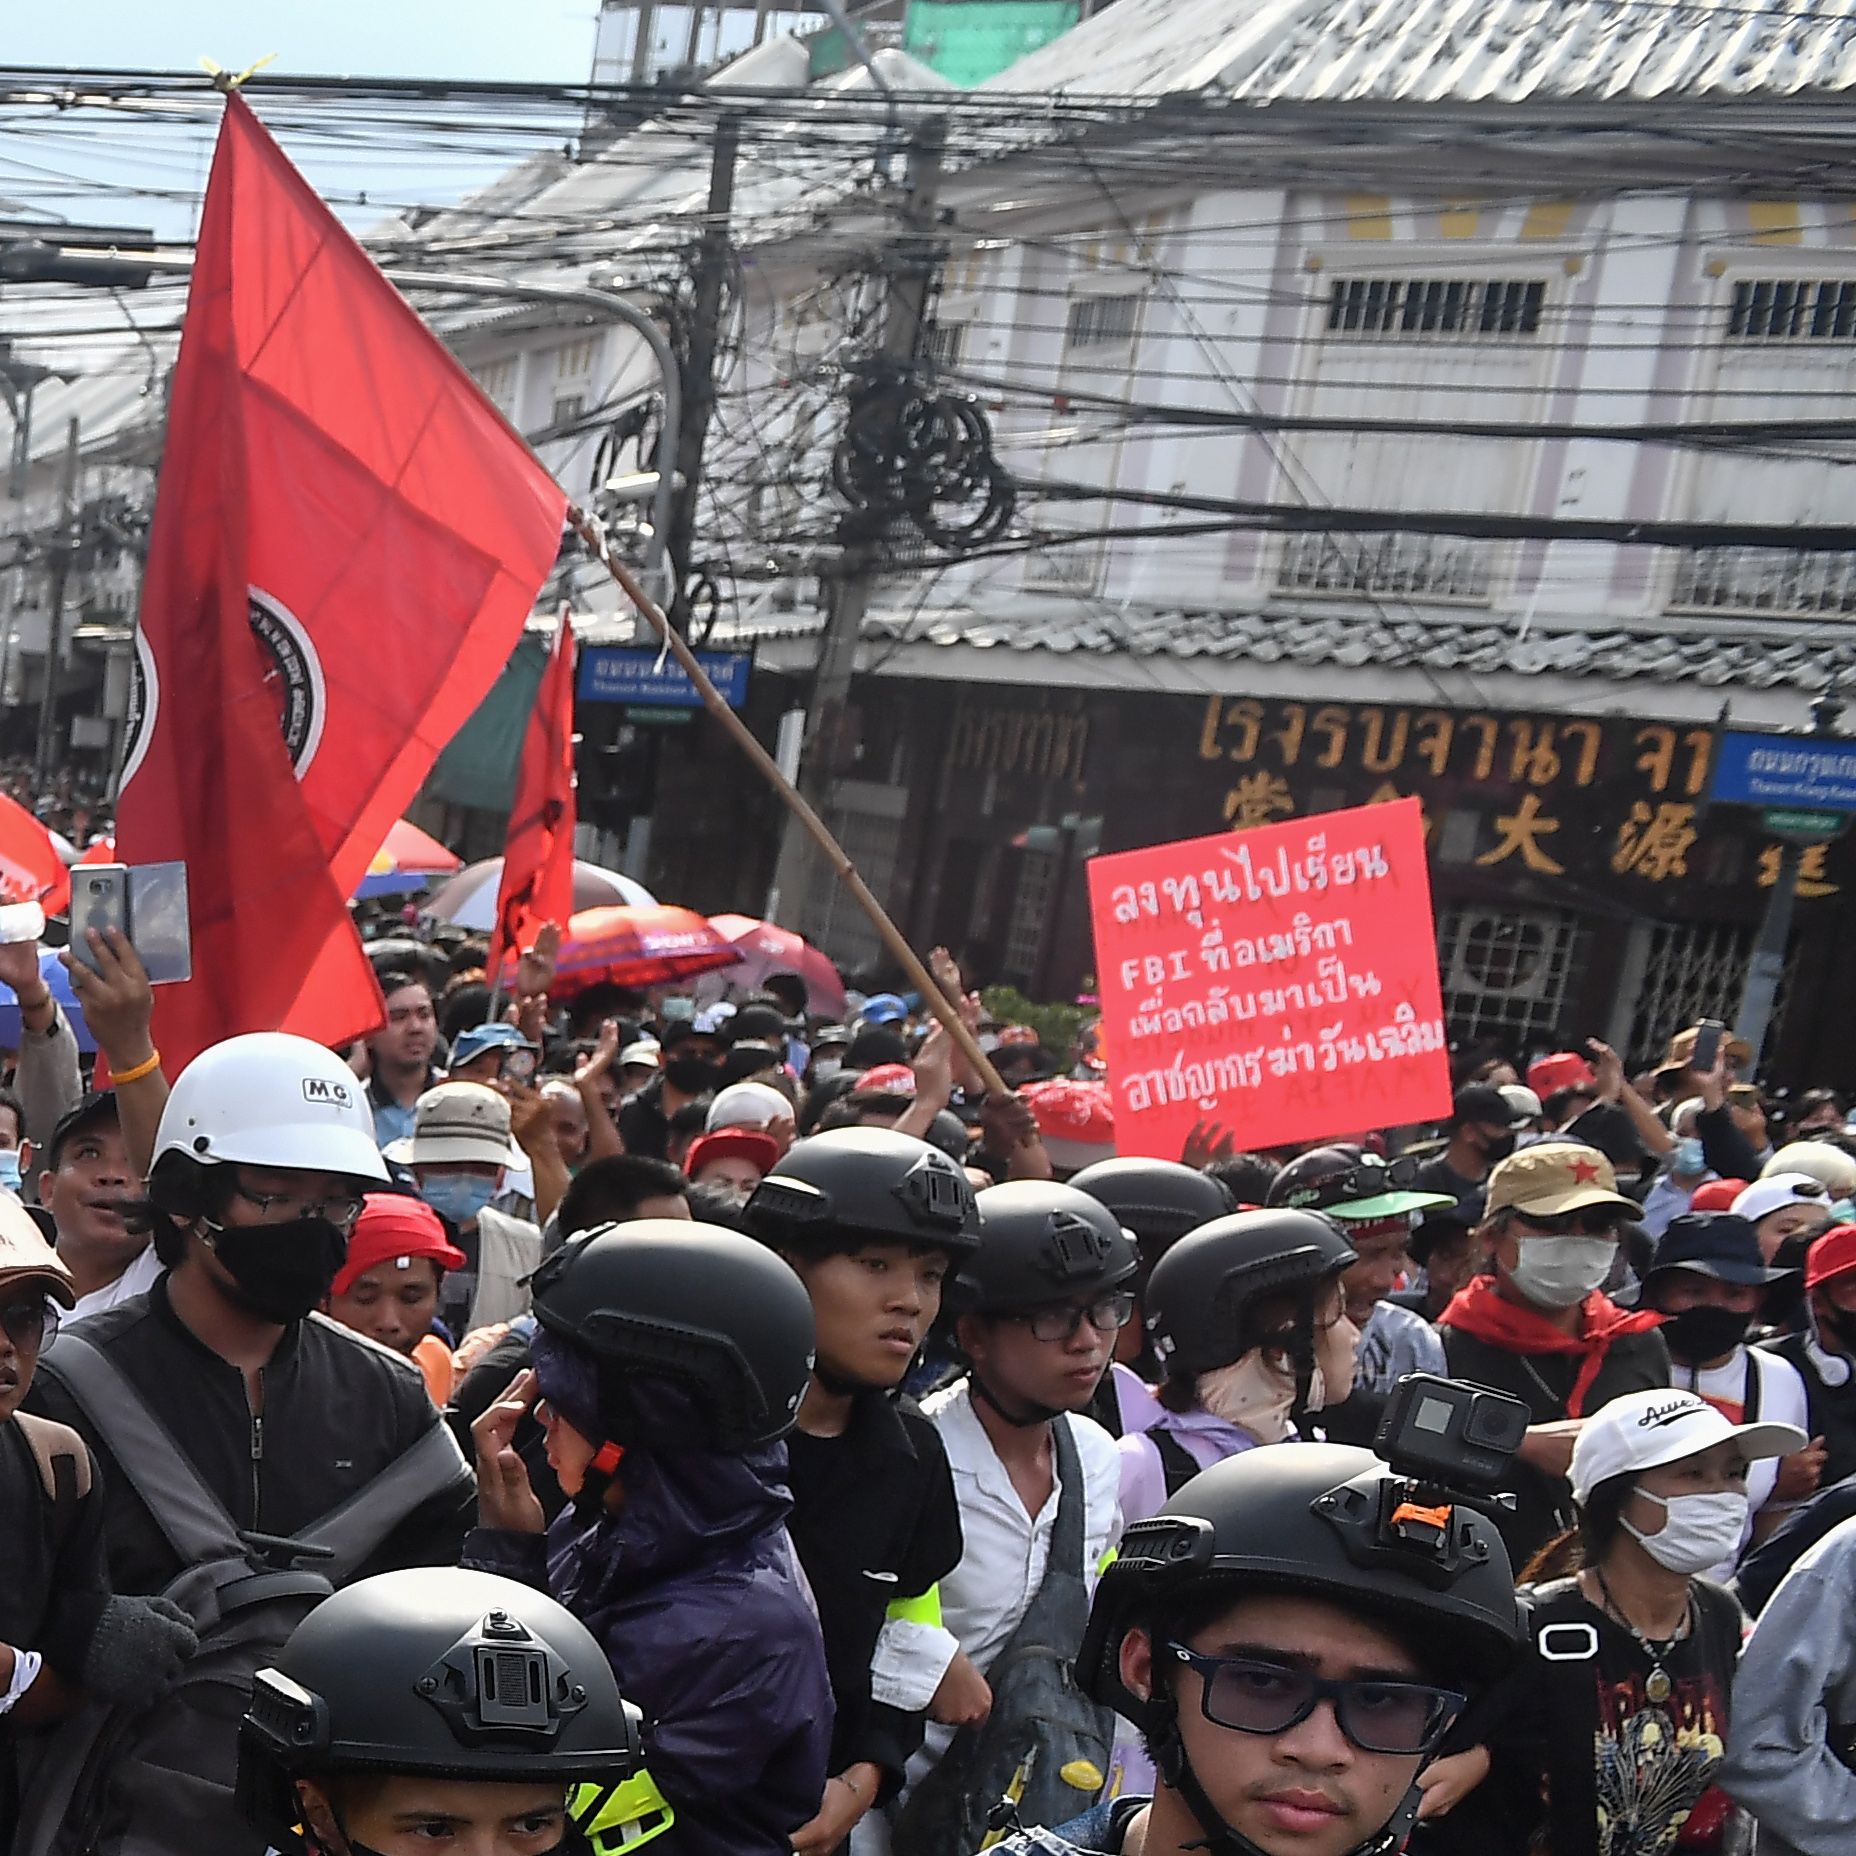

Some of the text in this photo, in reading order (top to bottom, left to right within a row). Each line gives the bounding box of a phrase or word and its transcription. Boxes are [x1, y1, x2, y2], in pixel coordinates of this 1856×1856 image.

[1111, 833, 1389, 929] ลงทุนไปเรียน
[1121, 951, 1194, 990] FBI
